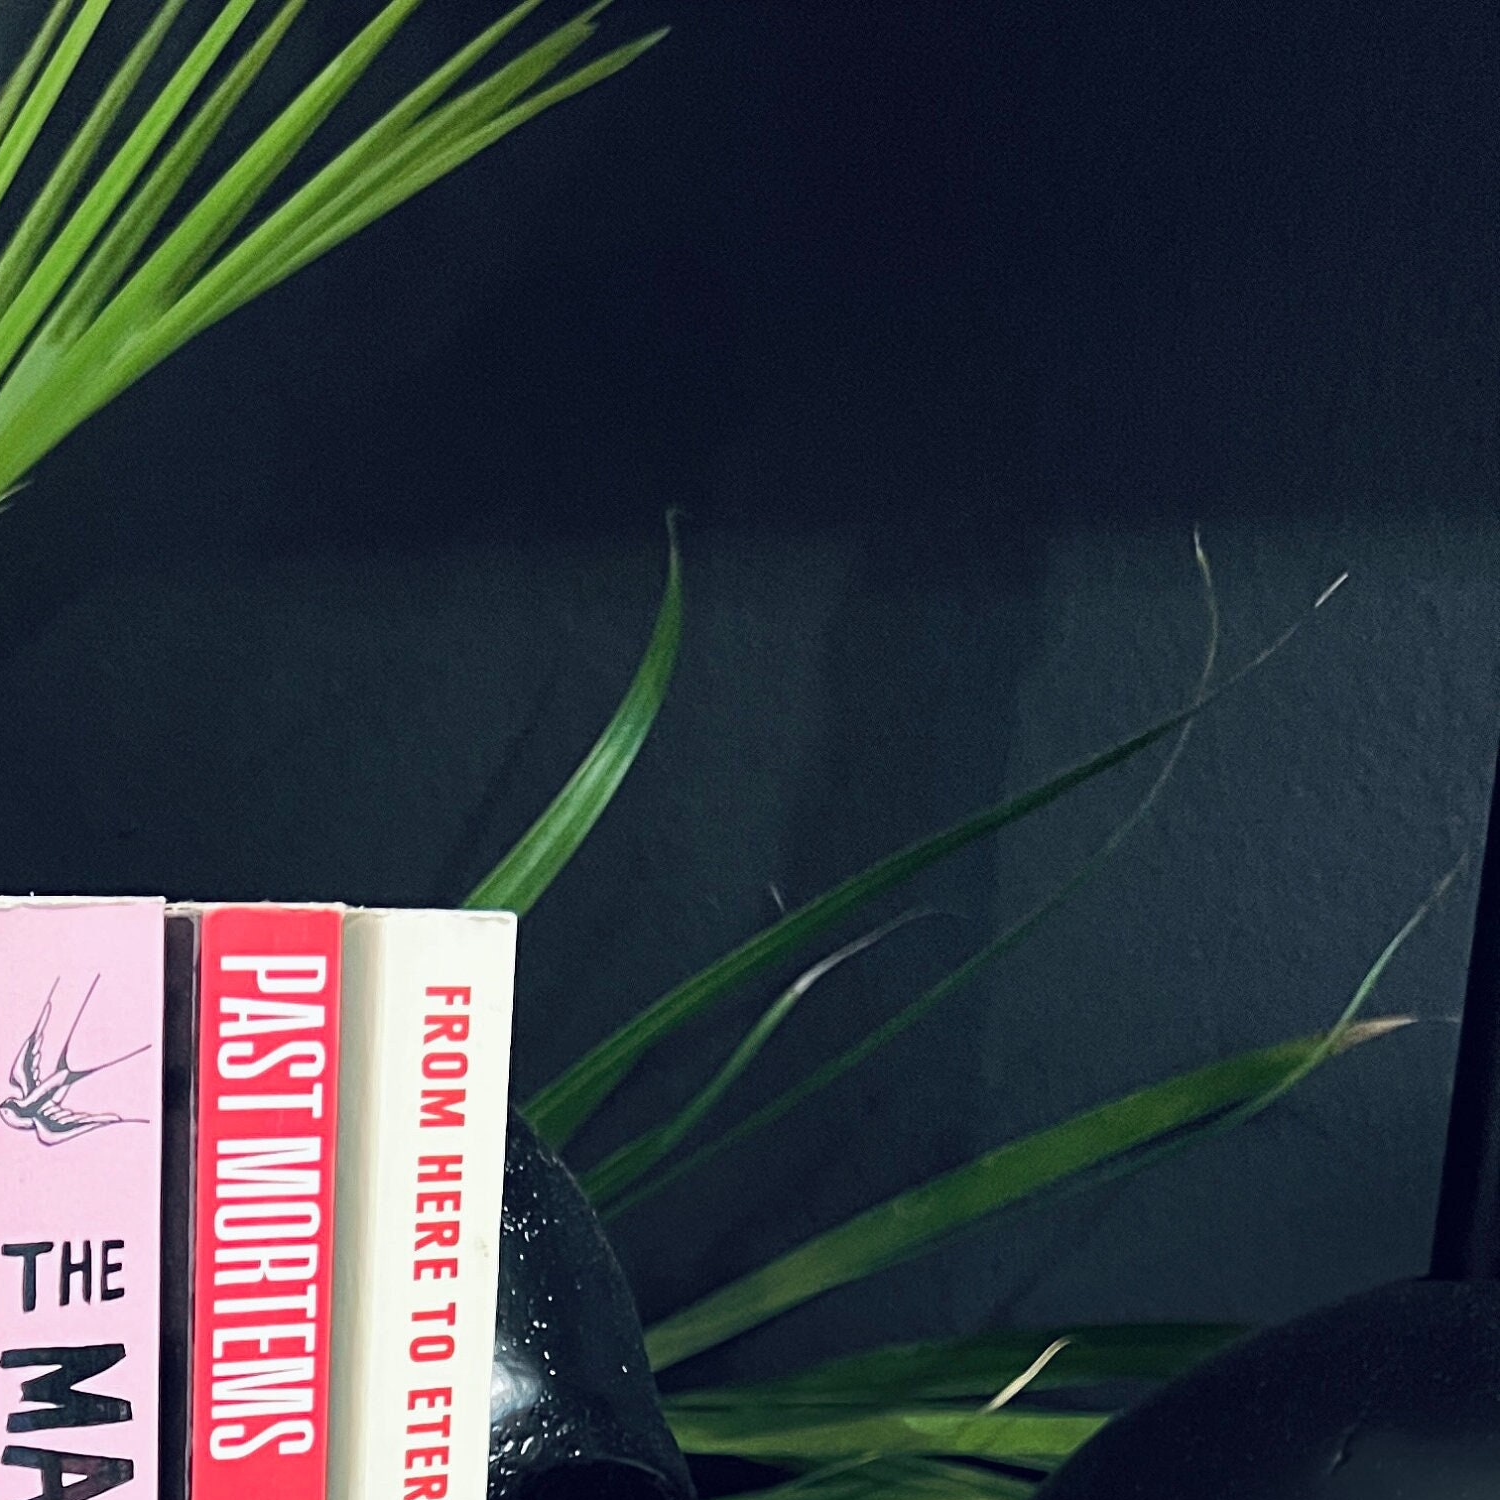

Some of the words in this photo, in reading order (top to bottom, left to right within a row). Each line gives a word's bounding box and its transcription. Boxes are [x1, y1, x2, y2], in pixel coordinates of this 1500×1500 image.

[216, 954, 328, 1120] PAST
[419, 985, 471, 1129] FROM
[0, 1239, 126, 1313] THE
[412, 1153, 464, 1282] HERE
[208, 1136, 323, 1461] MORTEMS
[409, 1301, 457, 1364] TO
